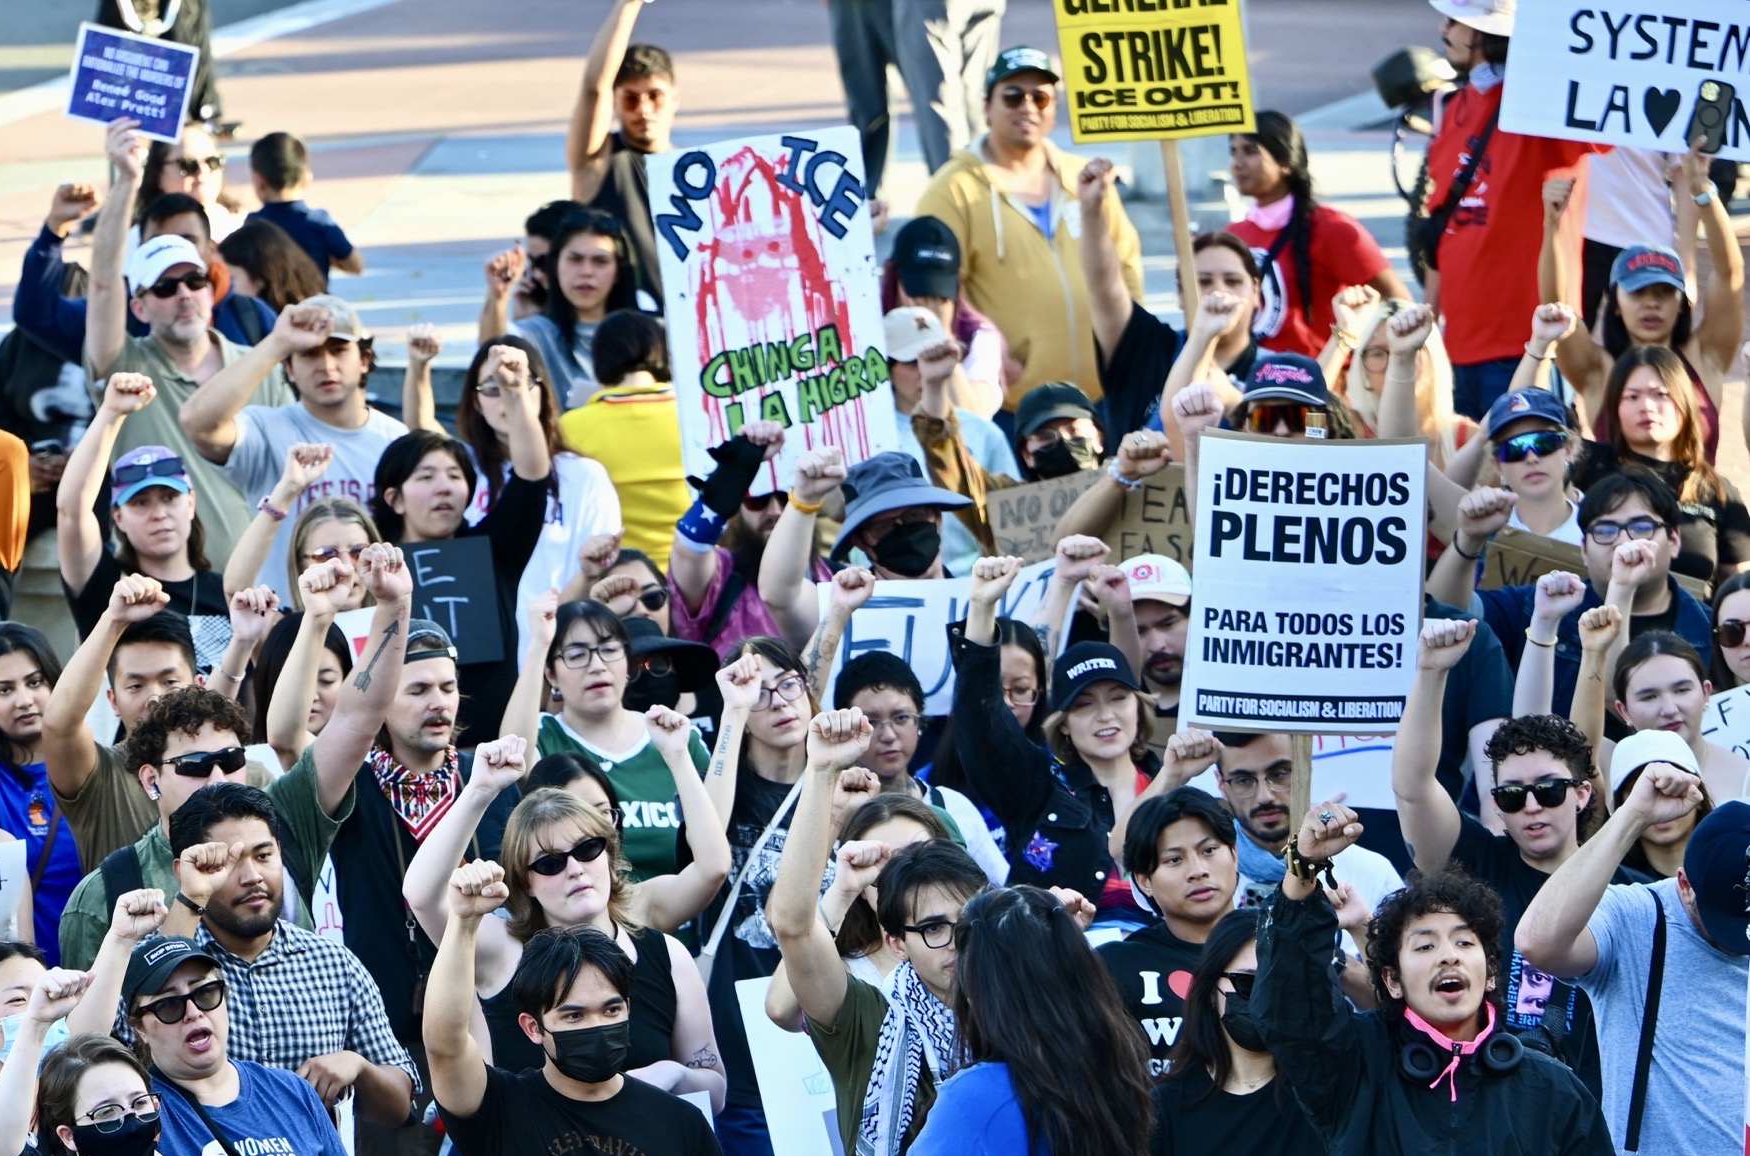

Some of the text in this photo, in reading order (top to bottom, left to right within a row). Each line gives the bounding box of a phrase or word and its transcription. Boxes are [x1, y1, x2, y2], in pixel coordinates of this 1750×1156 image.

[1081, 24, 1225, 84] STRIKE!
[1076, 81, 1240, 109] ICE OUT!
[1565, 80, 1631, 134] LA
[1081, 107, 1241, 132] PARTY FOR SOCIALISM & LIBERATION
[656, 136, 866, 262] NO ICE
[700, 323, 842, 398] CHINGA
[796, 346, 889, 423] MIGRA
[1213, 467, 1409, 506] ¡DERECHOS
[1209, 510, 1407, 565] PLENOS
[1204, 607, 1405, 636] PARA TODOS LOS
[1066, 656, 1117, 680] WRITER
[1202, 636, 1403, 669] INMIGRANTES!
[1198, 694, 1402, 719] PARTY FOR SOCIALISM & LIBERATION
[619, 800, 681, 829] XICO
[150, 942, 188, 960] SKIP INTRO
[1138, 970, 1163, 1005] I
